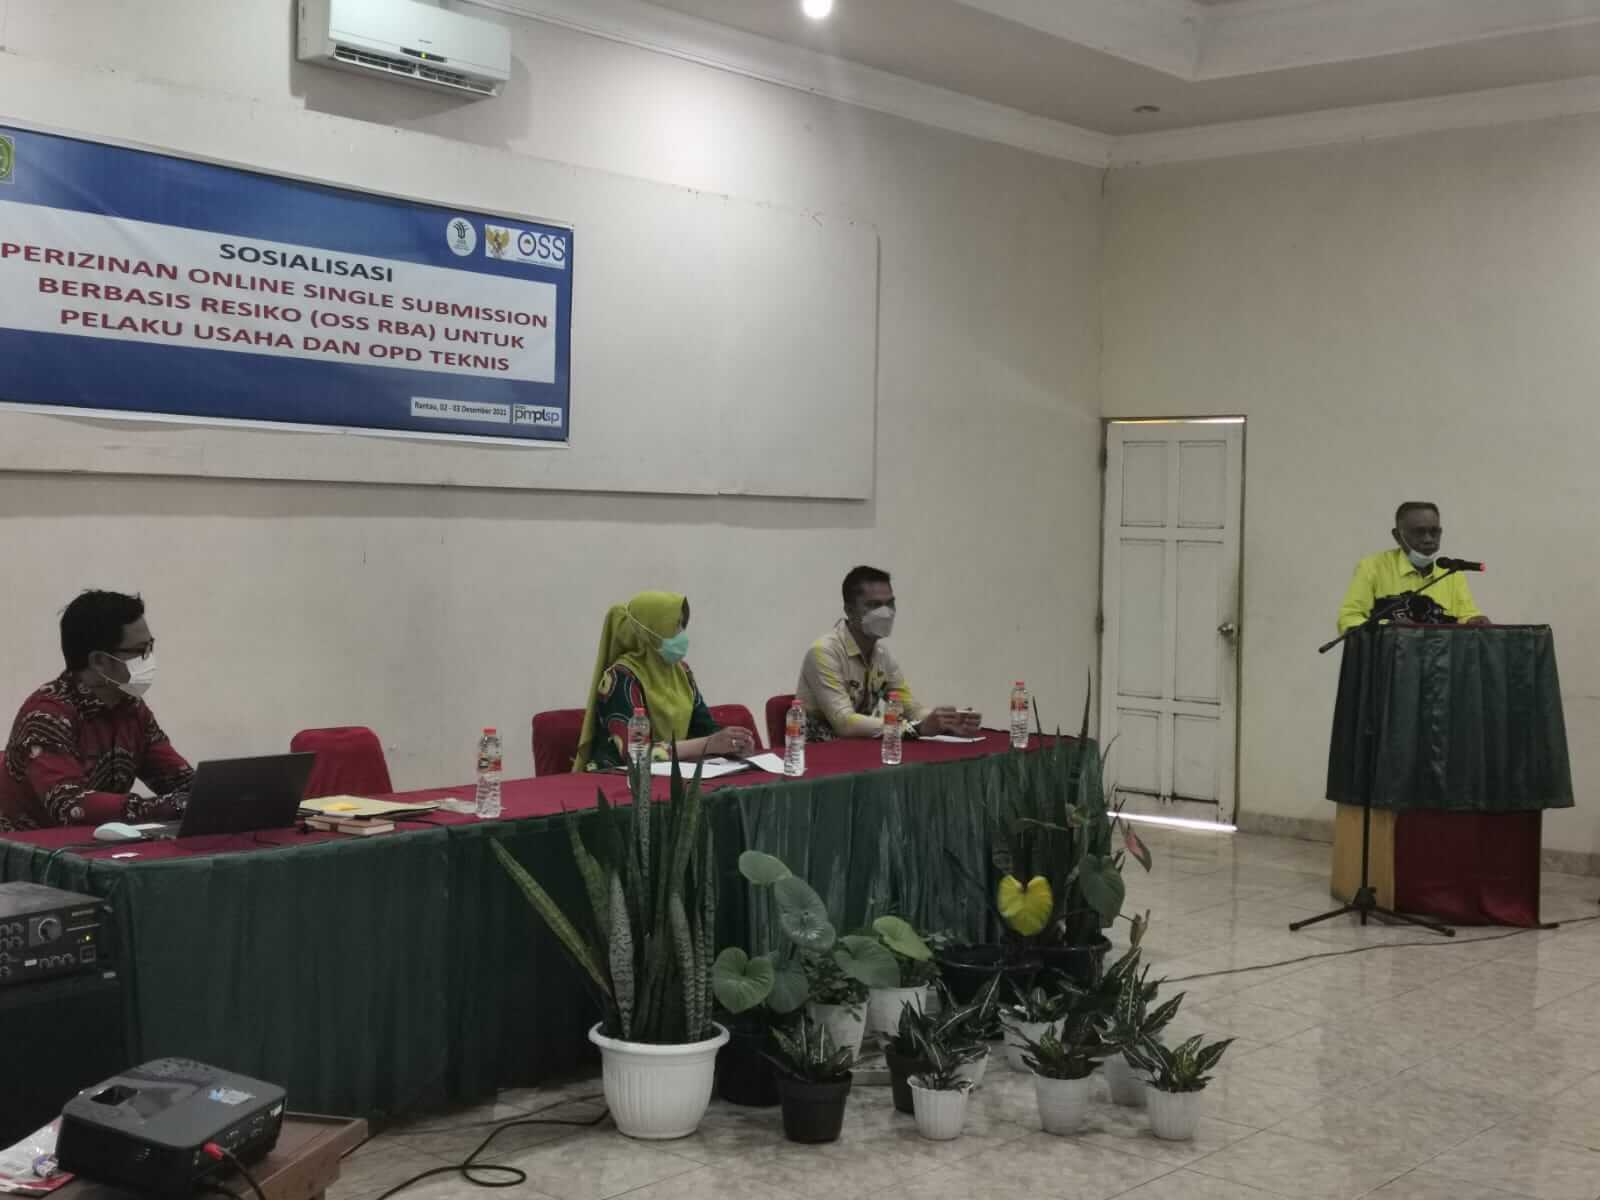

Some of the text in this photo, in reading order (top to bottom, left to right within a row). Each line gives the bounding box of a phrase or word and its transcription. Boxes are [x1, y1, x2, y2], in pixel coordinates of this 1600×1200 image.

[219, 243, 393, 283] SOSIALISASI
[518, 231, 565, 261] OSS
[1, 242, 548, 328] PERIZINAN ONLINE SINGLE SUBMISSION
[38, 277, 525, 349] BERBASIS RESIKO (OSS RBA) UNTUK
[60, 309, 510, 371] PELAKU USAHA DAN OPD TEKNIS
